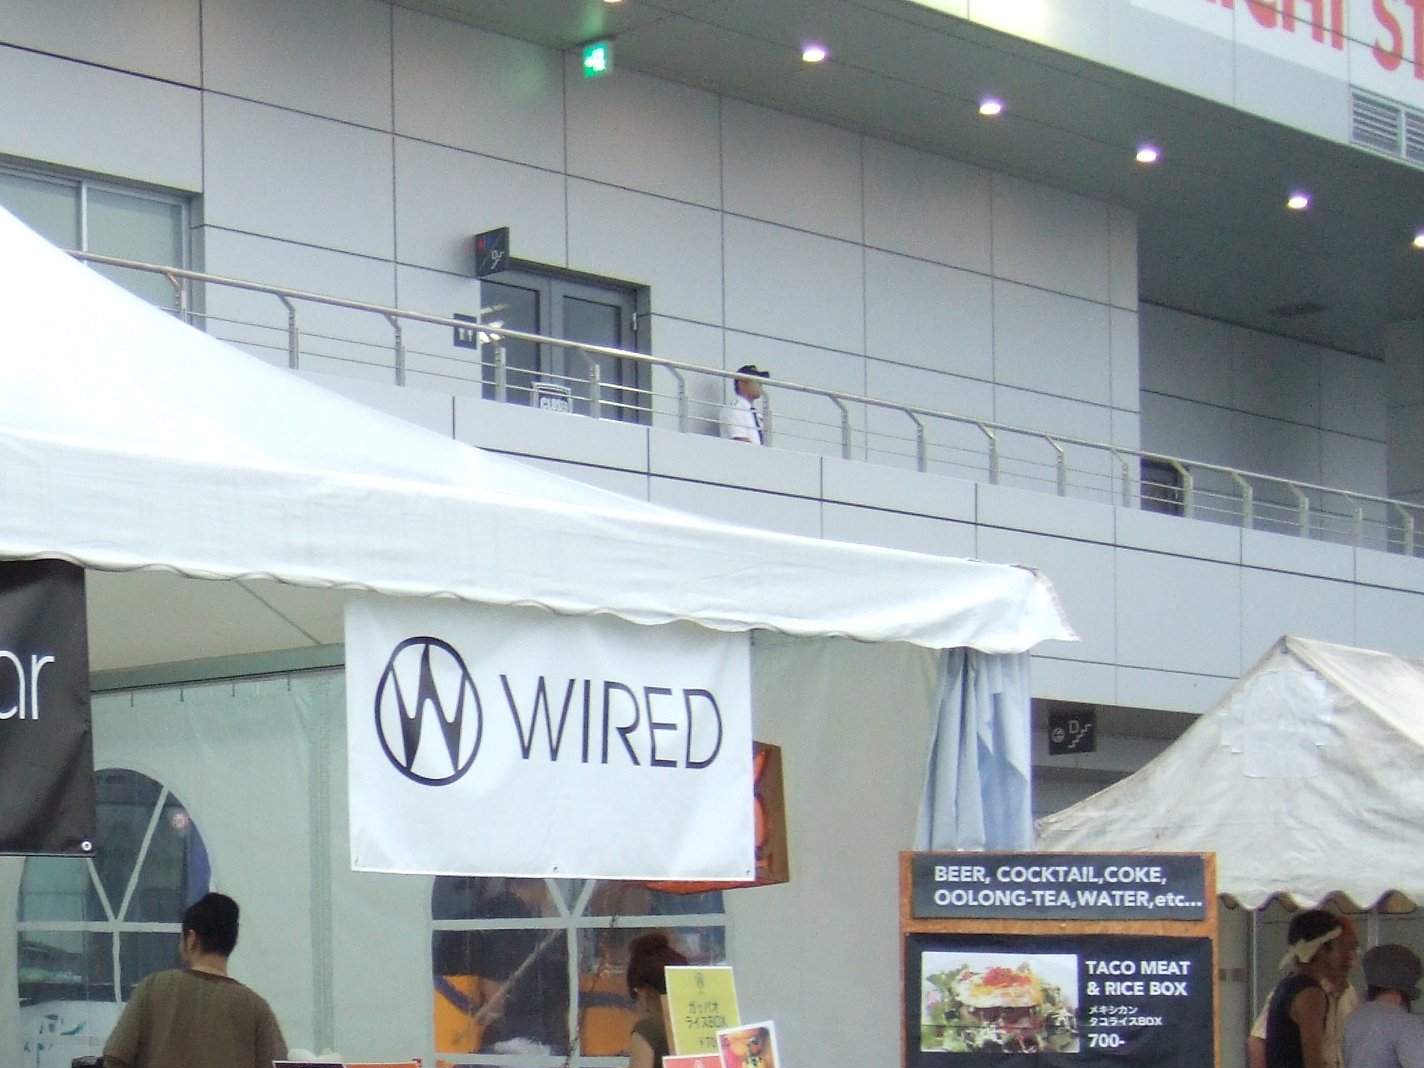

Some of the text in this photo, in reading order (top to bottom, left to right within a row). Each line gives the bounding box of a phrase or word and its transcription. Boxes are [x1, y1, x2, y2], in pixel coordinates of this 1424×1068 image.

[499, 674, 723, 769] WIRED
[934, 866, 991, 884] BEER,
[1086, 960, 1190, 976] TACO MEAT
[1087, 981, 1188, 996] & RICE BOX
